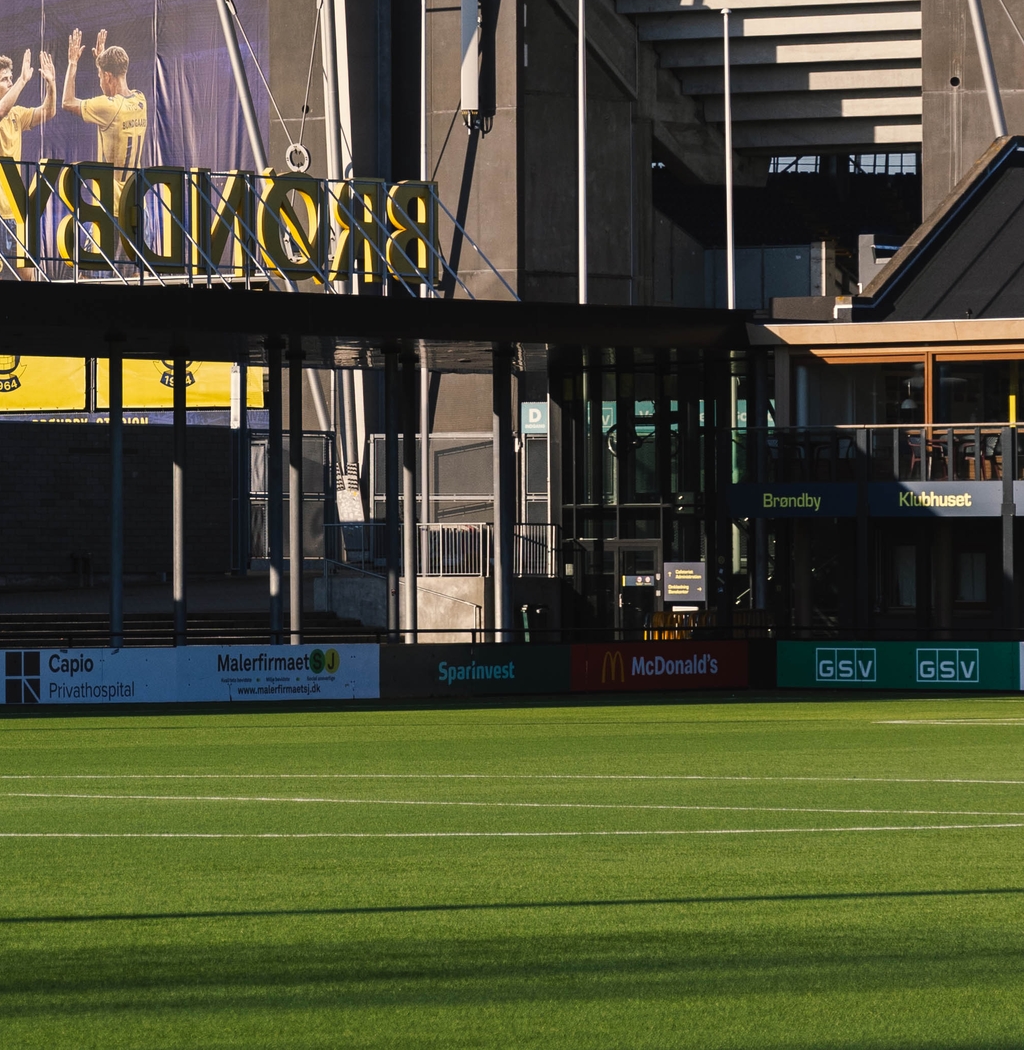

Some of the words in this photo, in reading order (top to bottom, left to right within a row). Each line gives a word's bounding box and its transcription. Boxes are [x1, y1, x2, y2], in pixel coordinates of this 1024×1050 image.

[164, 375, 193, 387] 194
[529, 408, 542, 423] D
[763, 492, 821, 512] Brøndby
[899, 492, 972, 508] Klubhuset
[48, 654, 94, 677] Capio
[438, 660, 515, 685] Sparinvest
[631, 653, 719, 678] McDonald's
[818, 659, 875, 679] GSV
[919, 659, 976, 680] GSV
[49, 681, 135, 700] Privathospital
[238, 683, 321, 696] www.malerfirmaetsj.dk
